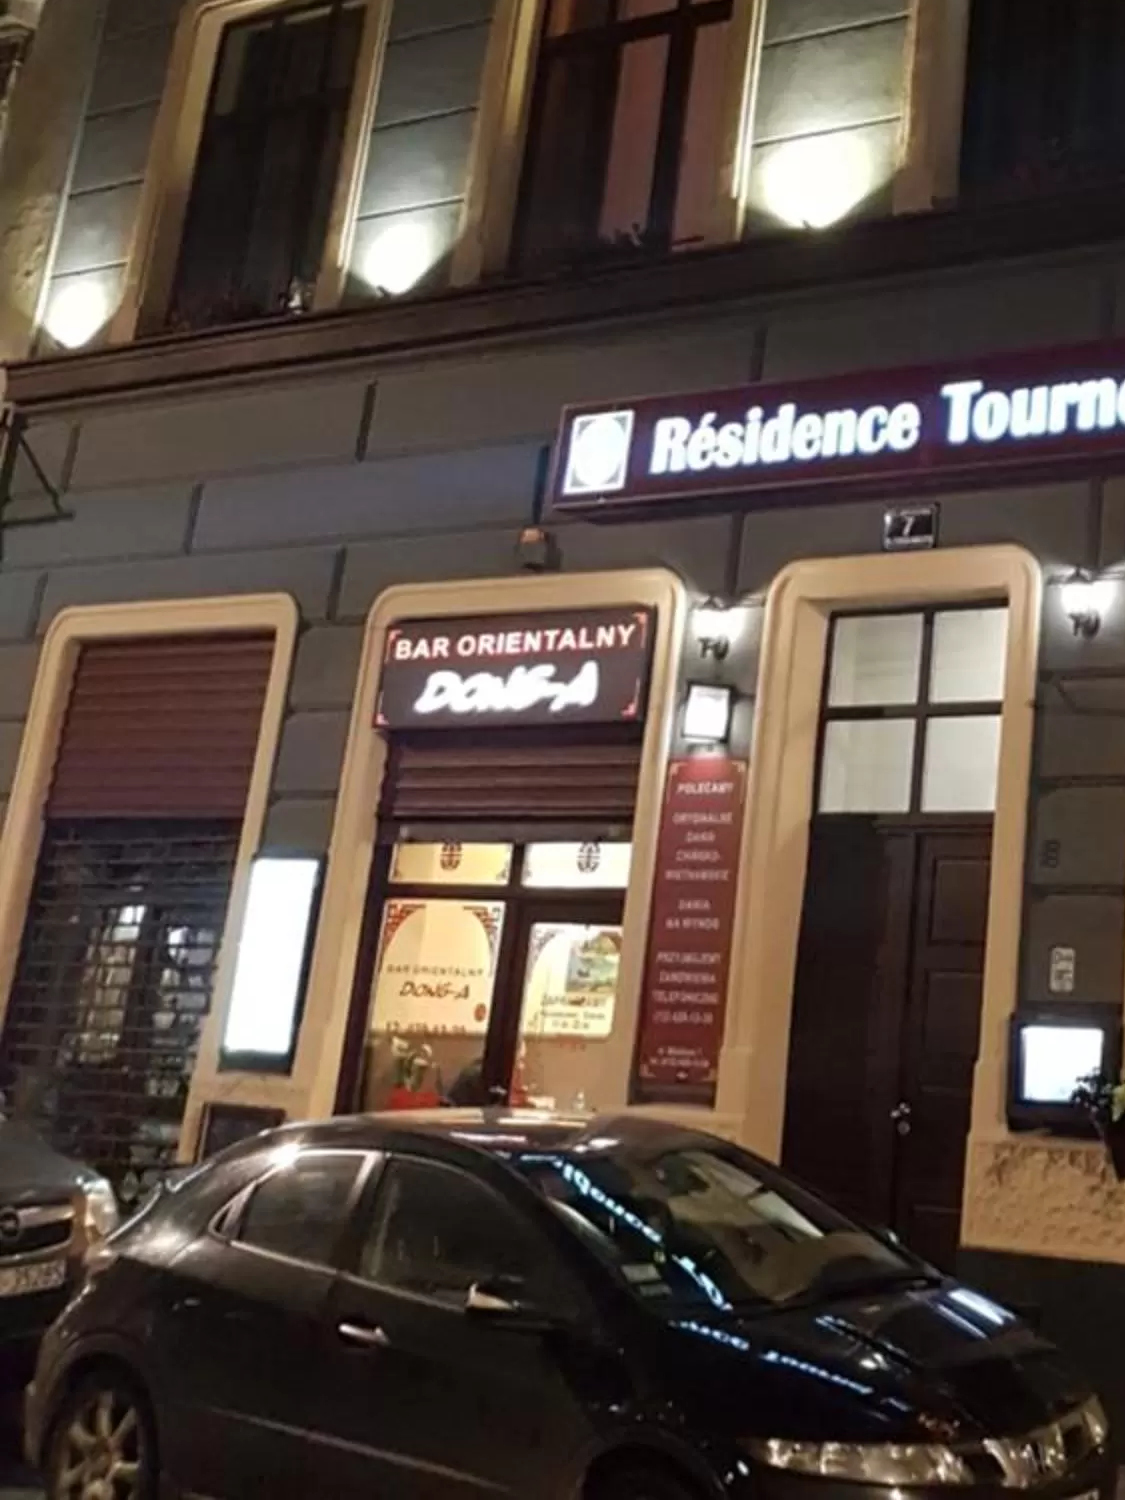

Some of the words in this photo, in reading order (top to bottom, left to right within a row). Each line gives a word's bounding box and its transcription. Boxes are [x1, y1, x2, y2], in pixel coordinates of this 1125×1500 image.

[648, 400, 921, 475] Résidence
[395, 636, 449, 661] BAR
[457, 624, 636, 657] ORIENTALNY
[399, 980, 471, 1000] DONG-A
